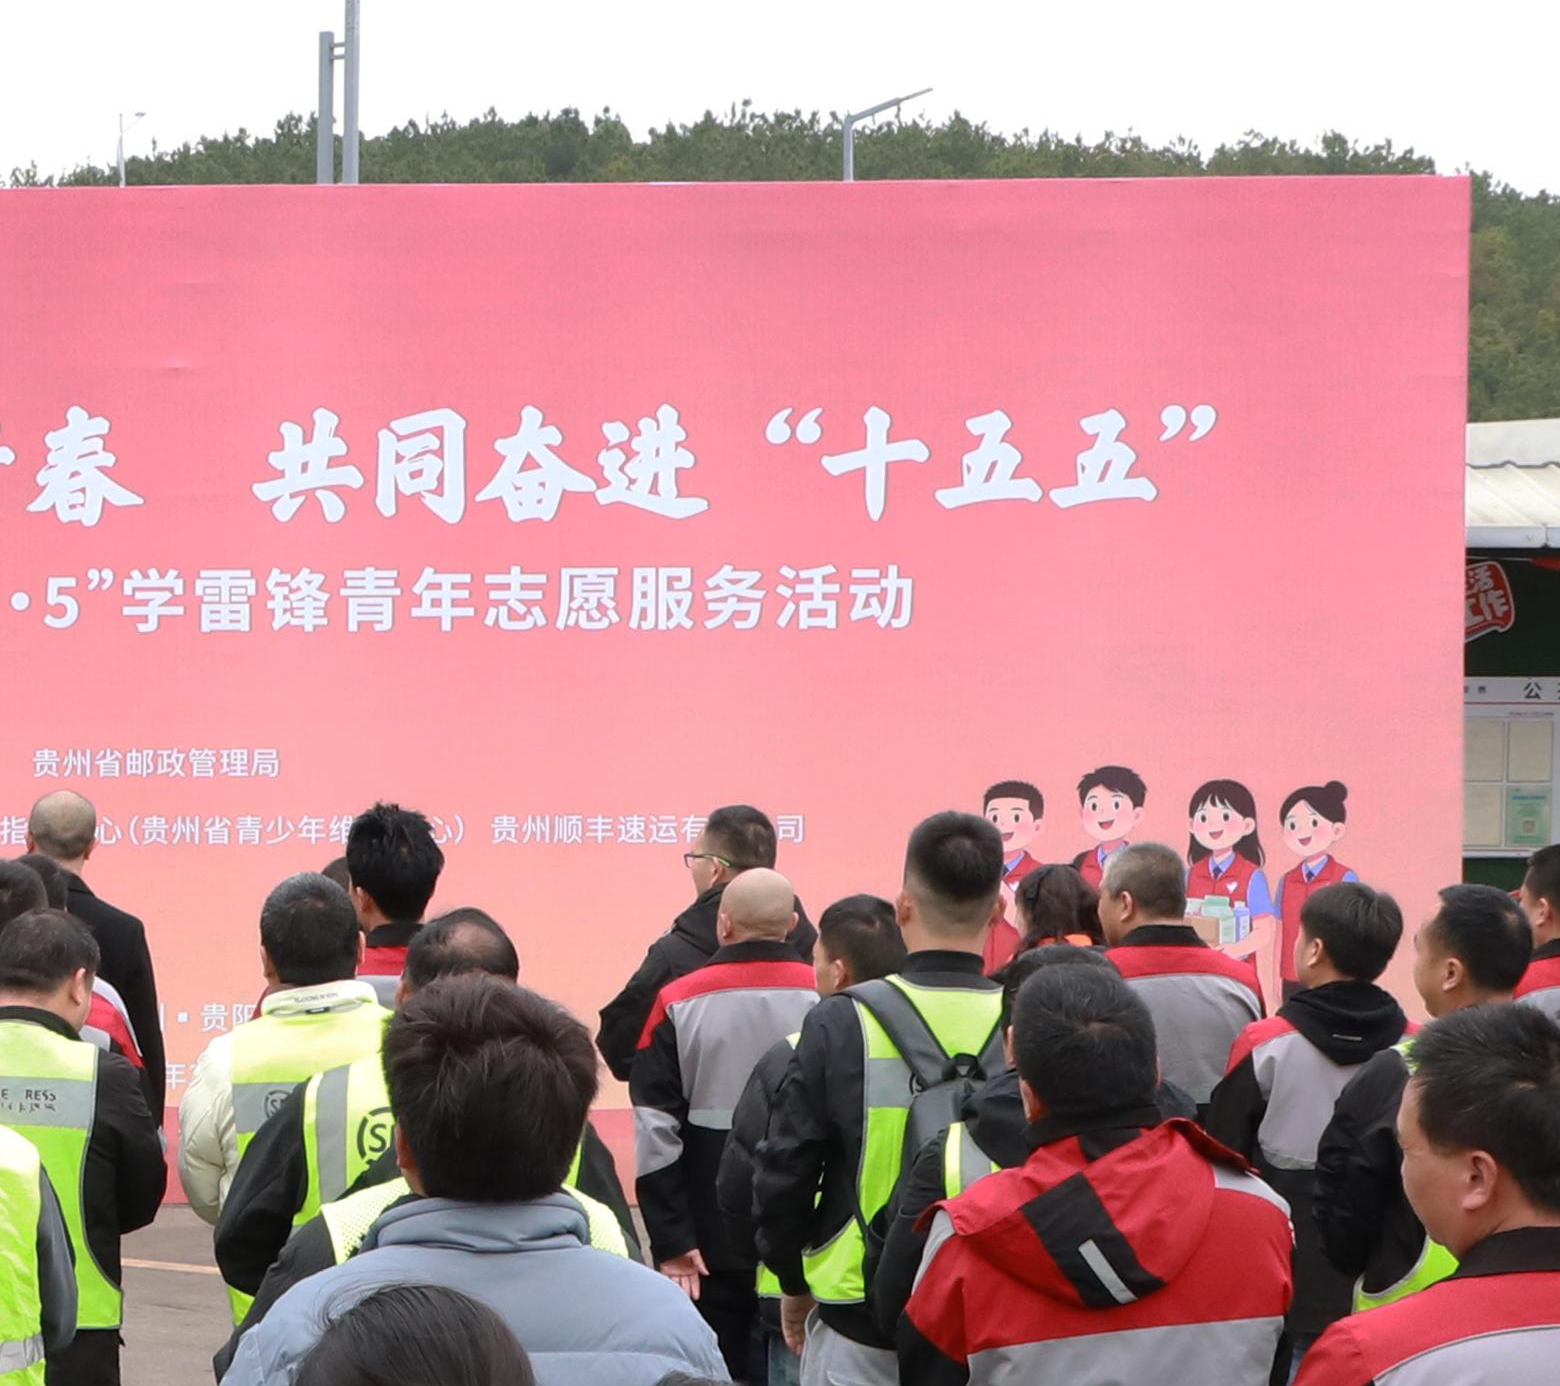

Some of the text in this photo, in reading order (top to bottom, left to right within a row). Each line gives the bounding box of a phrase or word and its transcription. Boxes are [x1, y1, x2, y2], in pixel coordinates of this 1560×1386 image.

[250, 401, 1218, 525] 共同奋进“十五五”
[32, 749, 280, 778] 贵州省邮政管理局
[490, 814, 806, 845] 贵州顺丰速运有司
